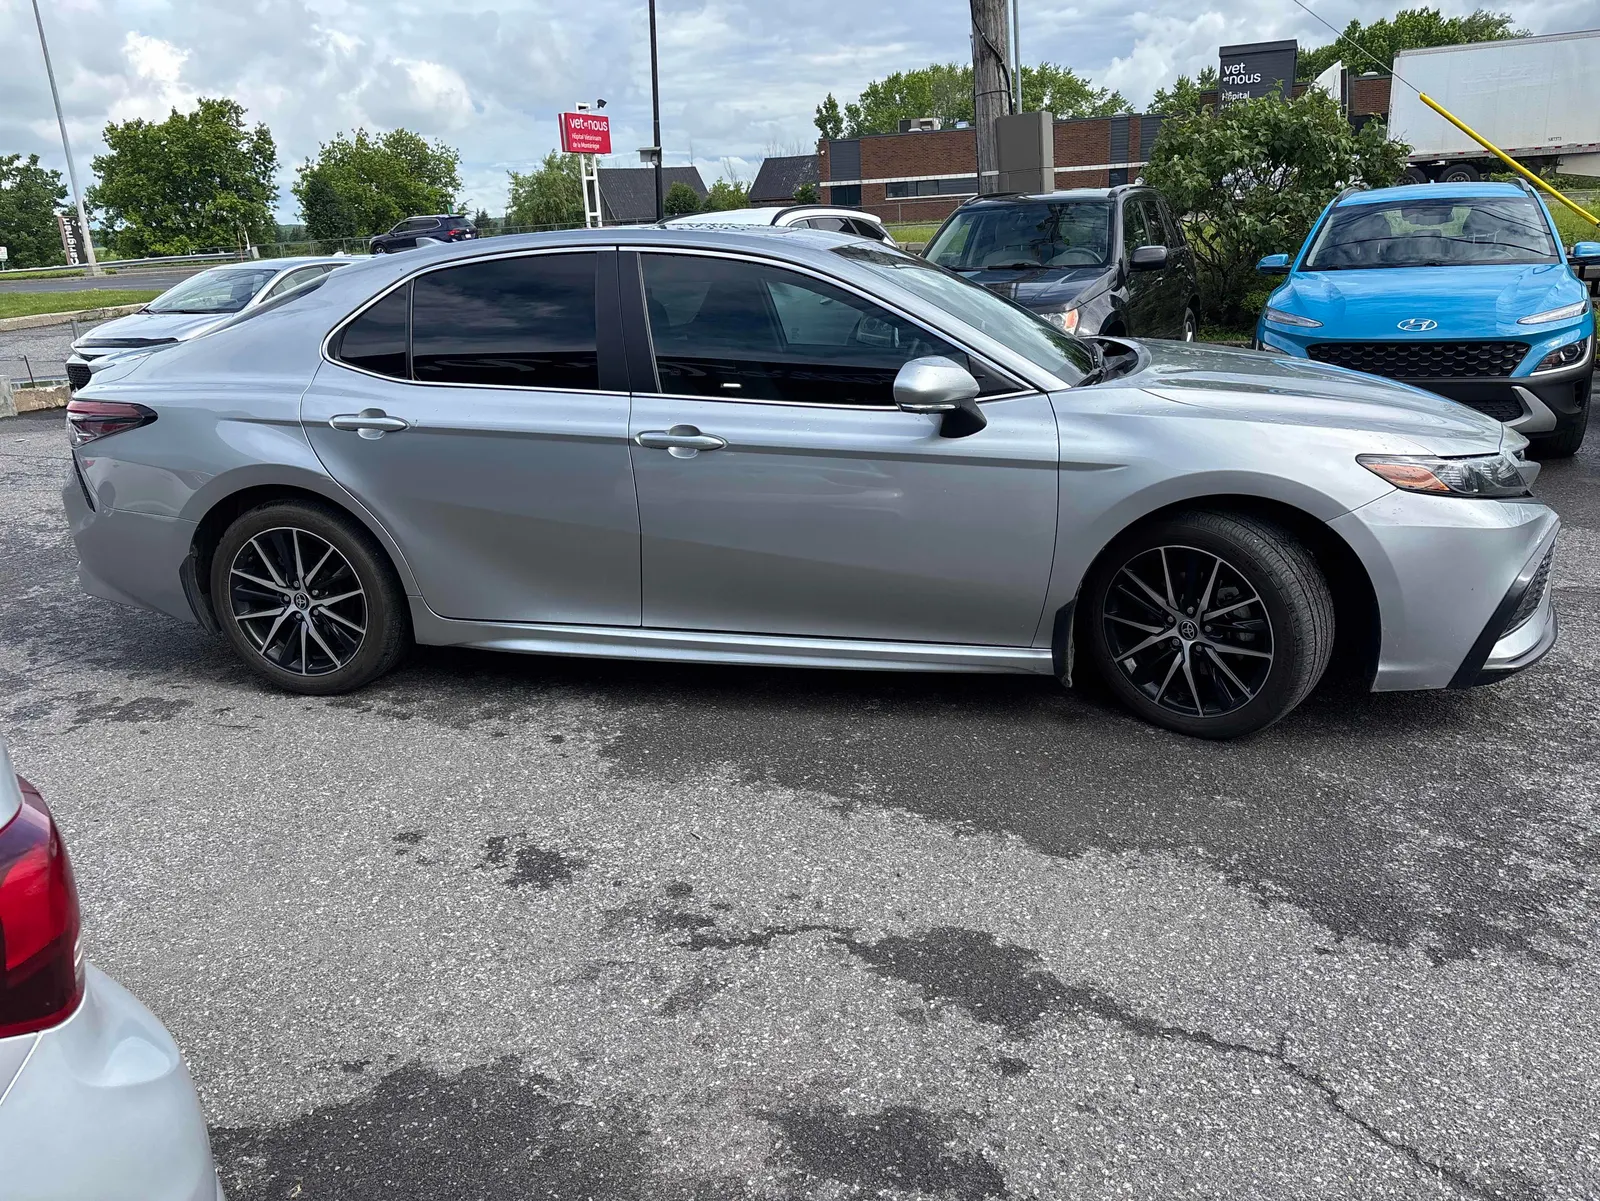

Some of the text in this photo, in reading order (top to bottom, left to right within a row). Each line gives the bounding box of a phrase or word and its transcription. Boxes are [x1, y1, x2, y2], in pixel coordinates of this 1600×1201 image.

[1224, 62, 1246, 75] vet
[1229, 73, 1261, 85] nous
[570, 117, 584, 129] vet
[588, 119, 608, 131] nous
[62, 217, 79, 266] Carignan
